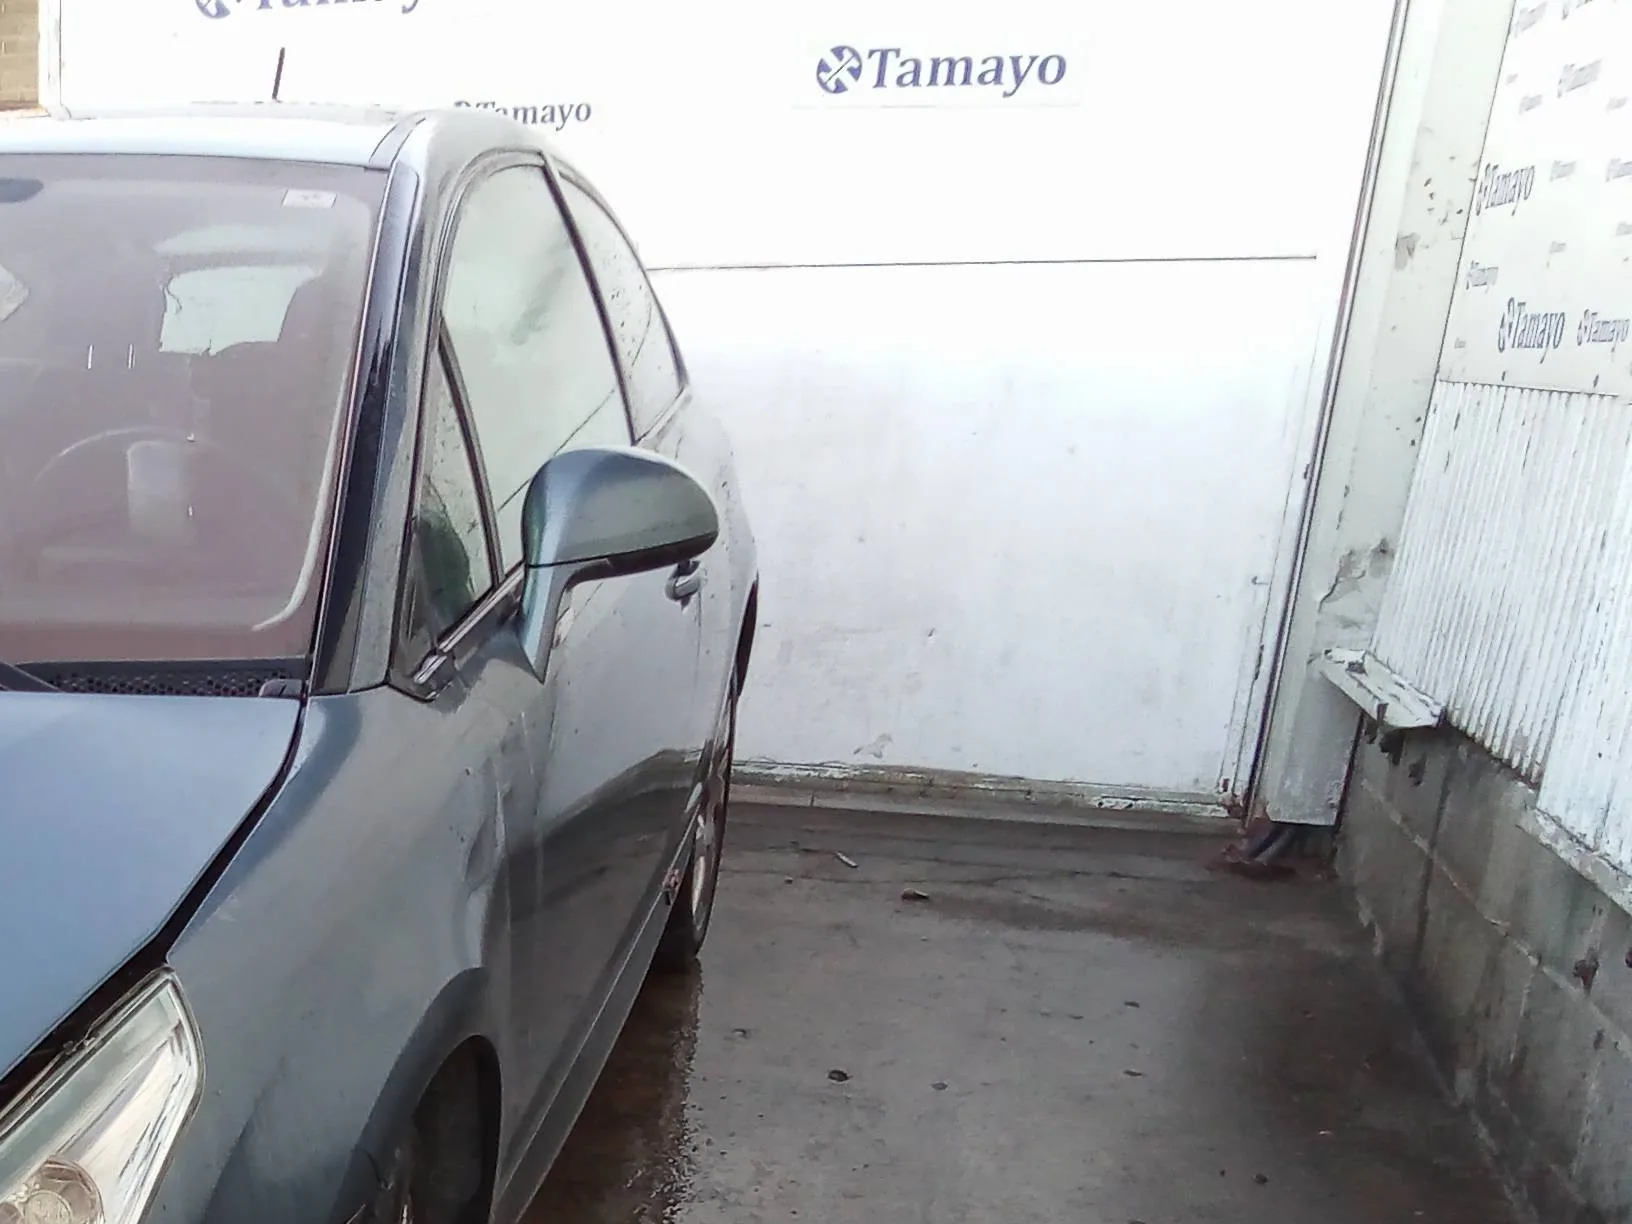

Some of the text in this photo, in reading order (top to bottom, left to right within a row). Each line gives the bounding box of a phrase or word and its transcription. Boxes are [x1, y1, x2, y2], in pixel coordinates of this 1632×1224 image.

[868, 47, 1067, 98] Tamayo
[475, 101, 591, 131] mayo
[1511, 301, 1565, 364] Tamayo
